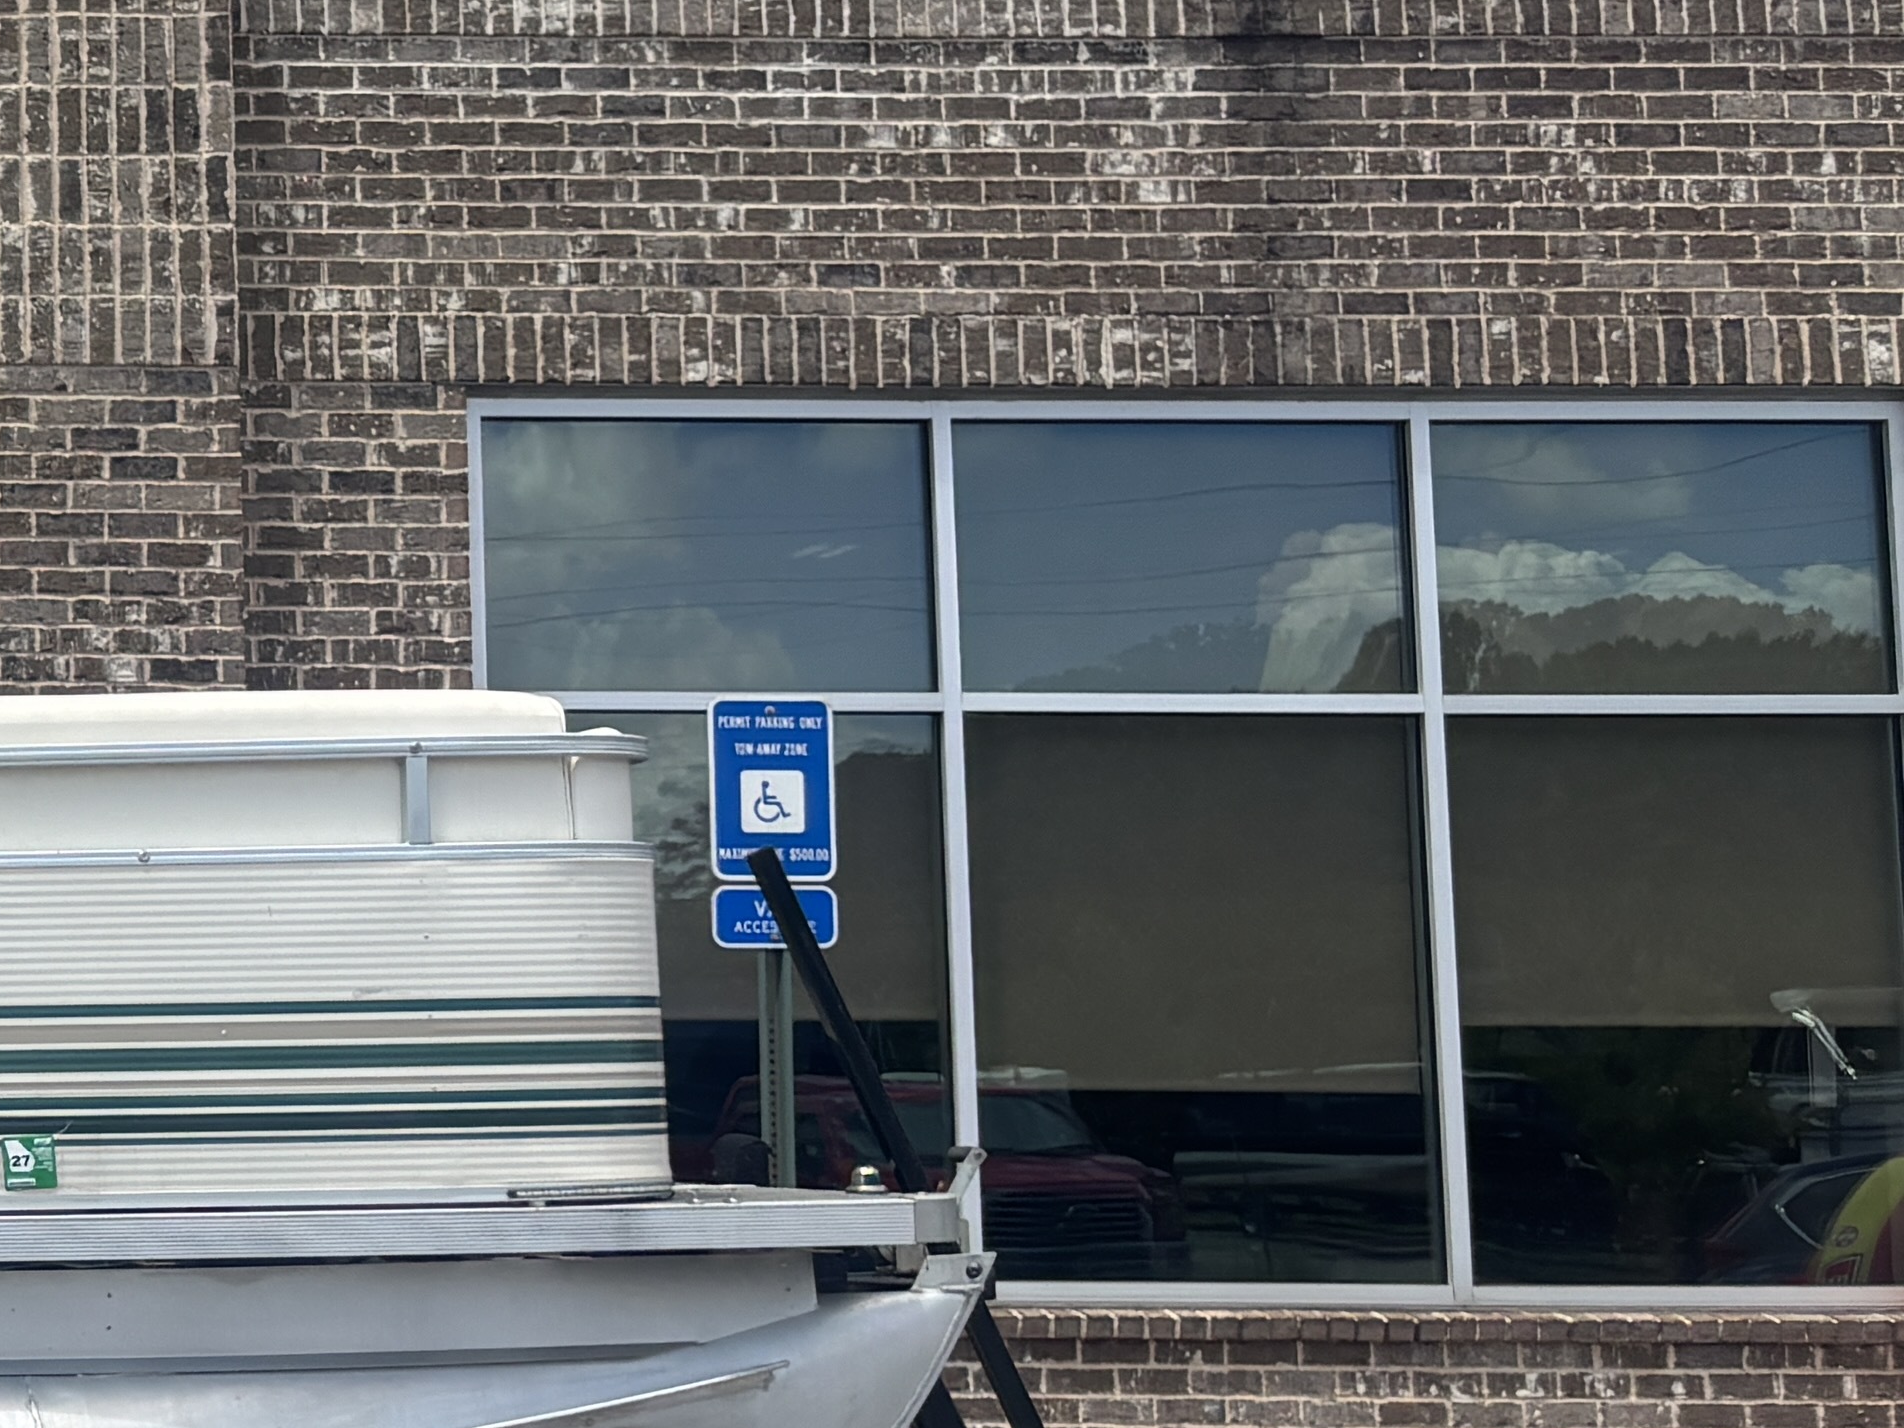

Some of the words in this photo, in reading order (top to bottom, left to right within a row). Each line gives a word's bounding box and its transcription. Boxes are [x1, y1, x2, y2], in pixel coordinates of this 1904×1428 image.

[718, 715, 751, 729] PERMIT
[755, 716, 795, 730] PARKING
[799, 716, 823, 730] ONLY
[11, 1154, 30, 1167] 27
